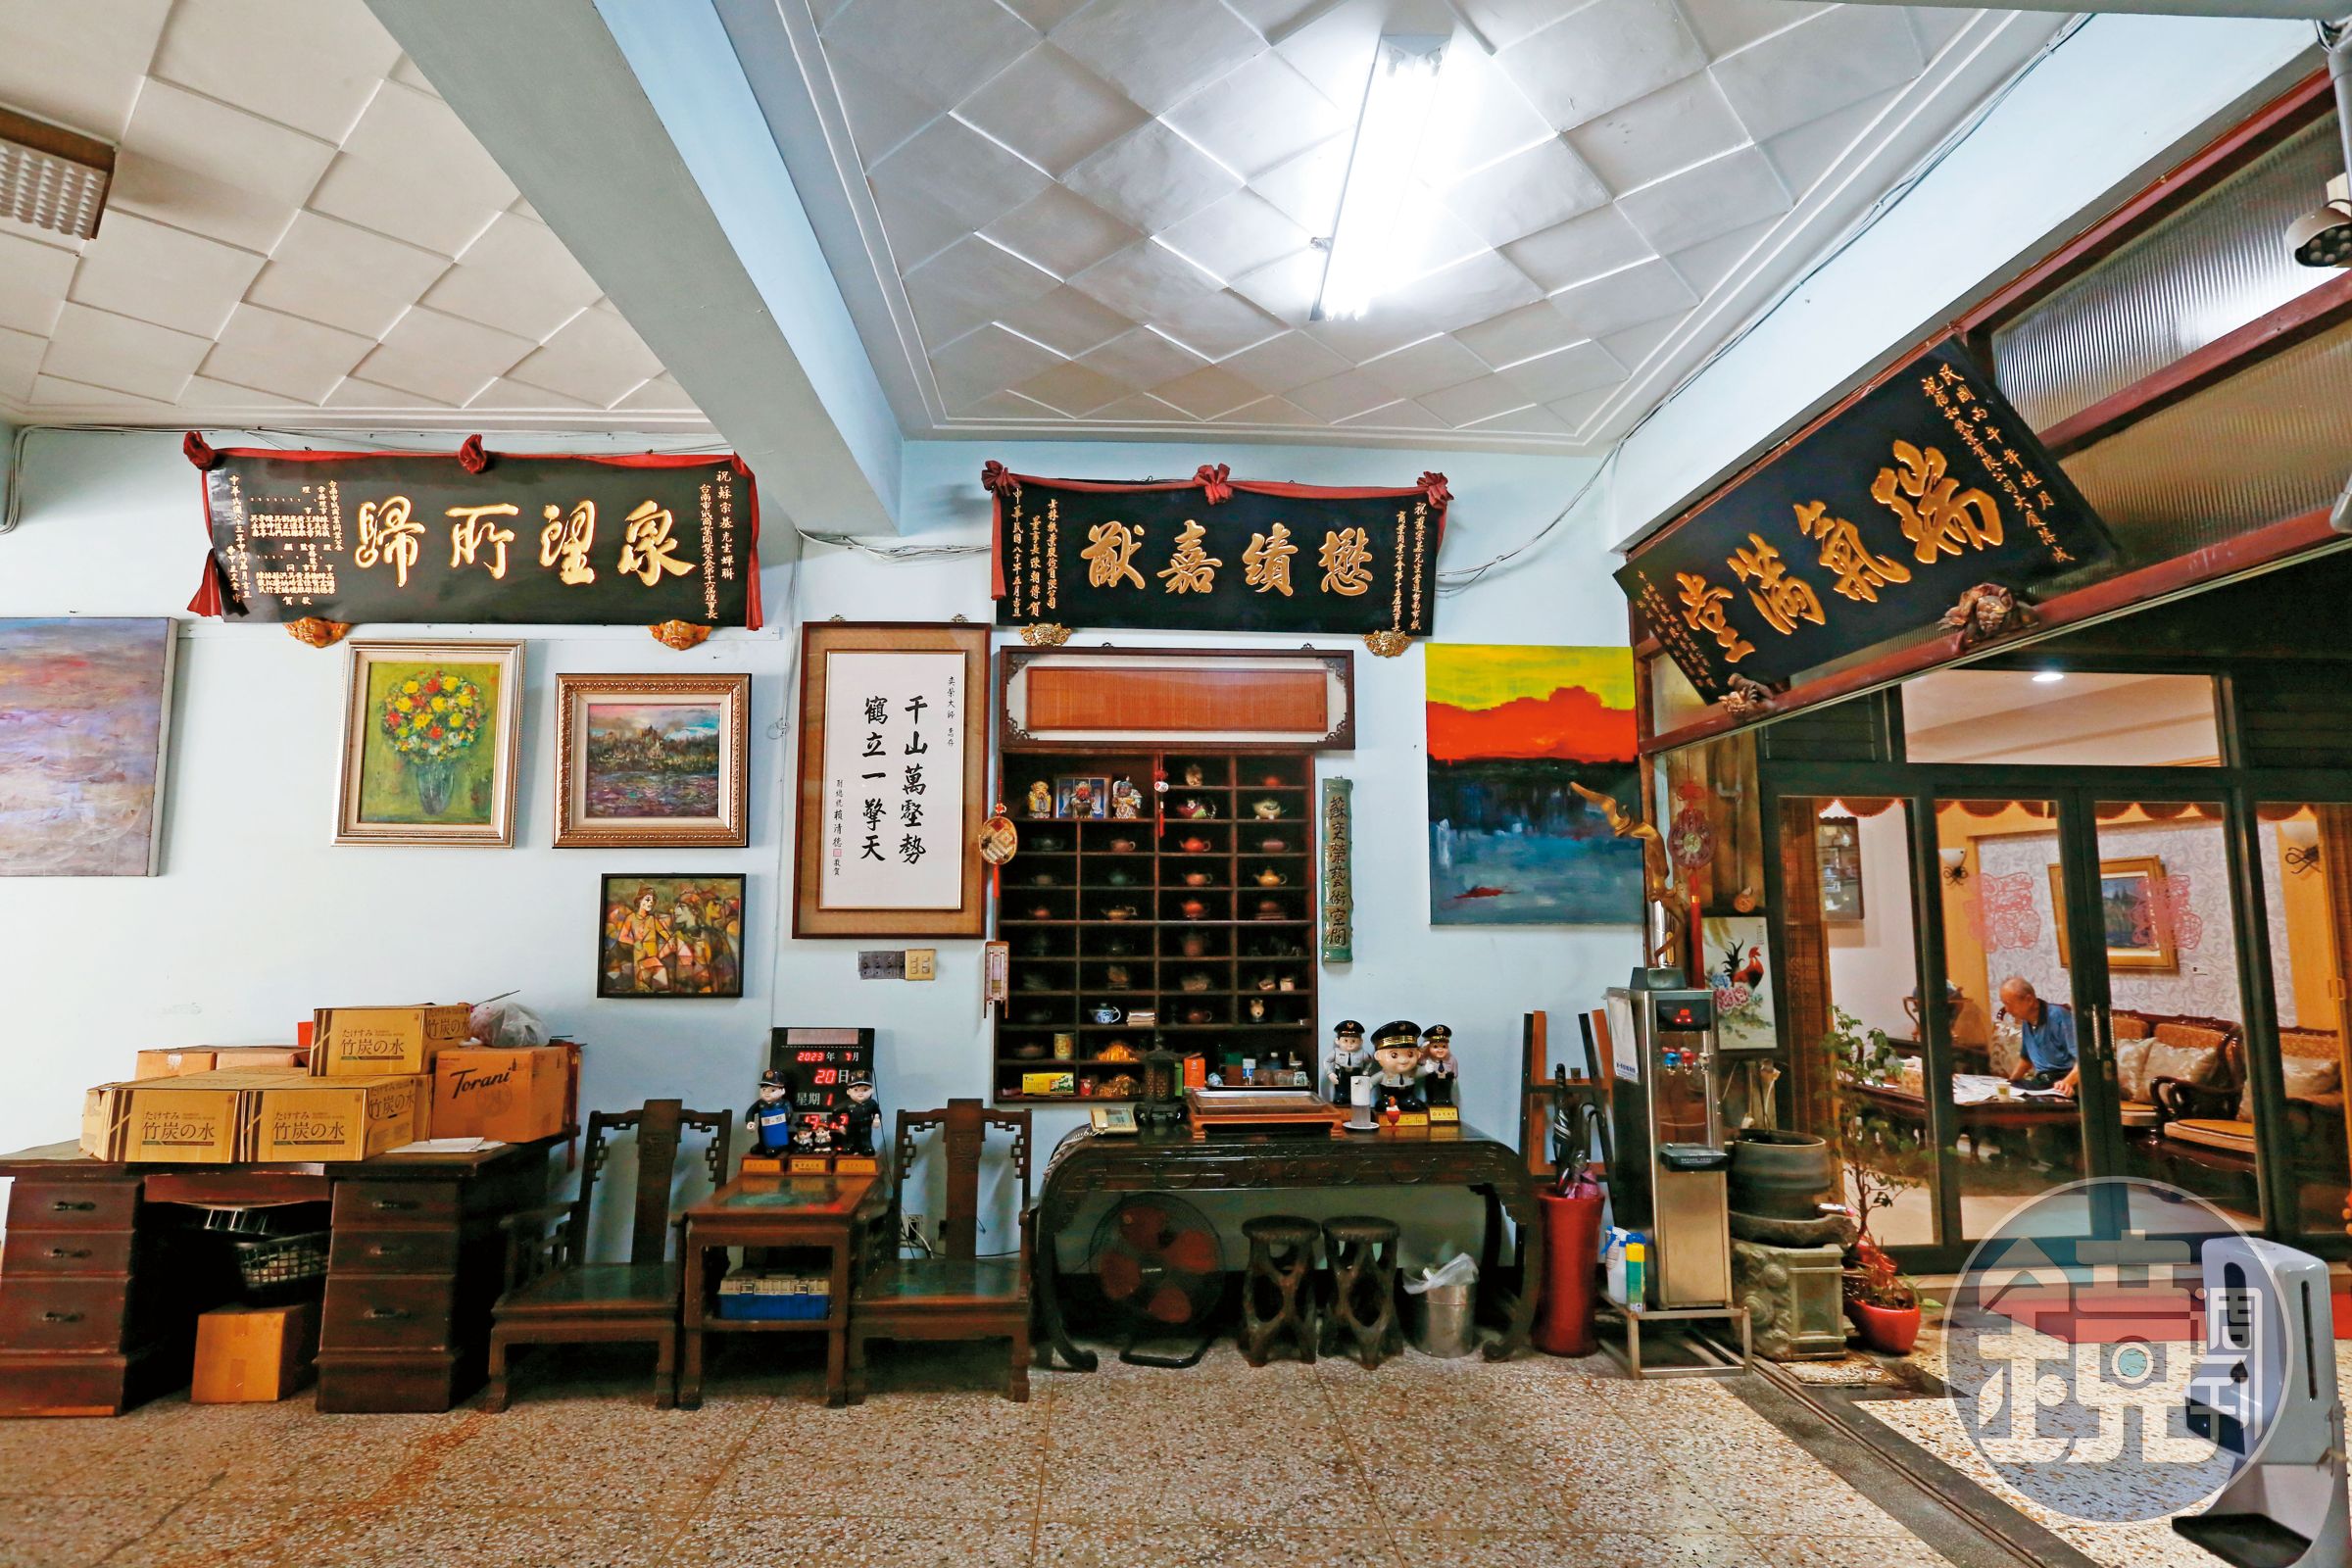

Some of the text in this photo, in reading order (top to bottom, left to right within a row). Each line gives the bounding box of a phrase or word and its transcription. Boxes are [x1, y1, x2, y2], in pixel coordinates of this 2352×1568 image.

[898, 694, 928, 863] 千山萬壑勢
[341, 1038, 405, 1055] 竹炭の水
[449, 1066, 514, 1099] Torani
[141, 1121, 216, 1141] 竹炭の水
[273, 1121, 345, 1141] 竹炭の水
